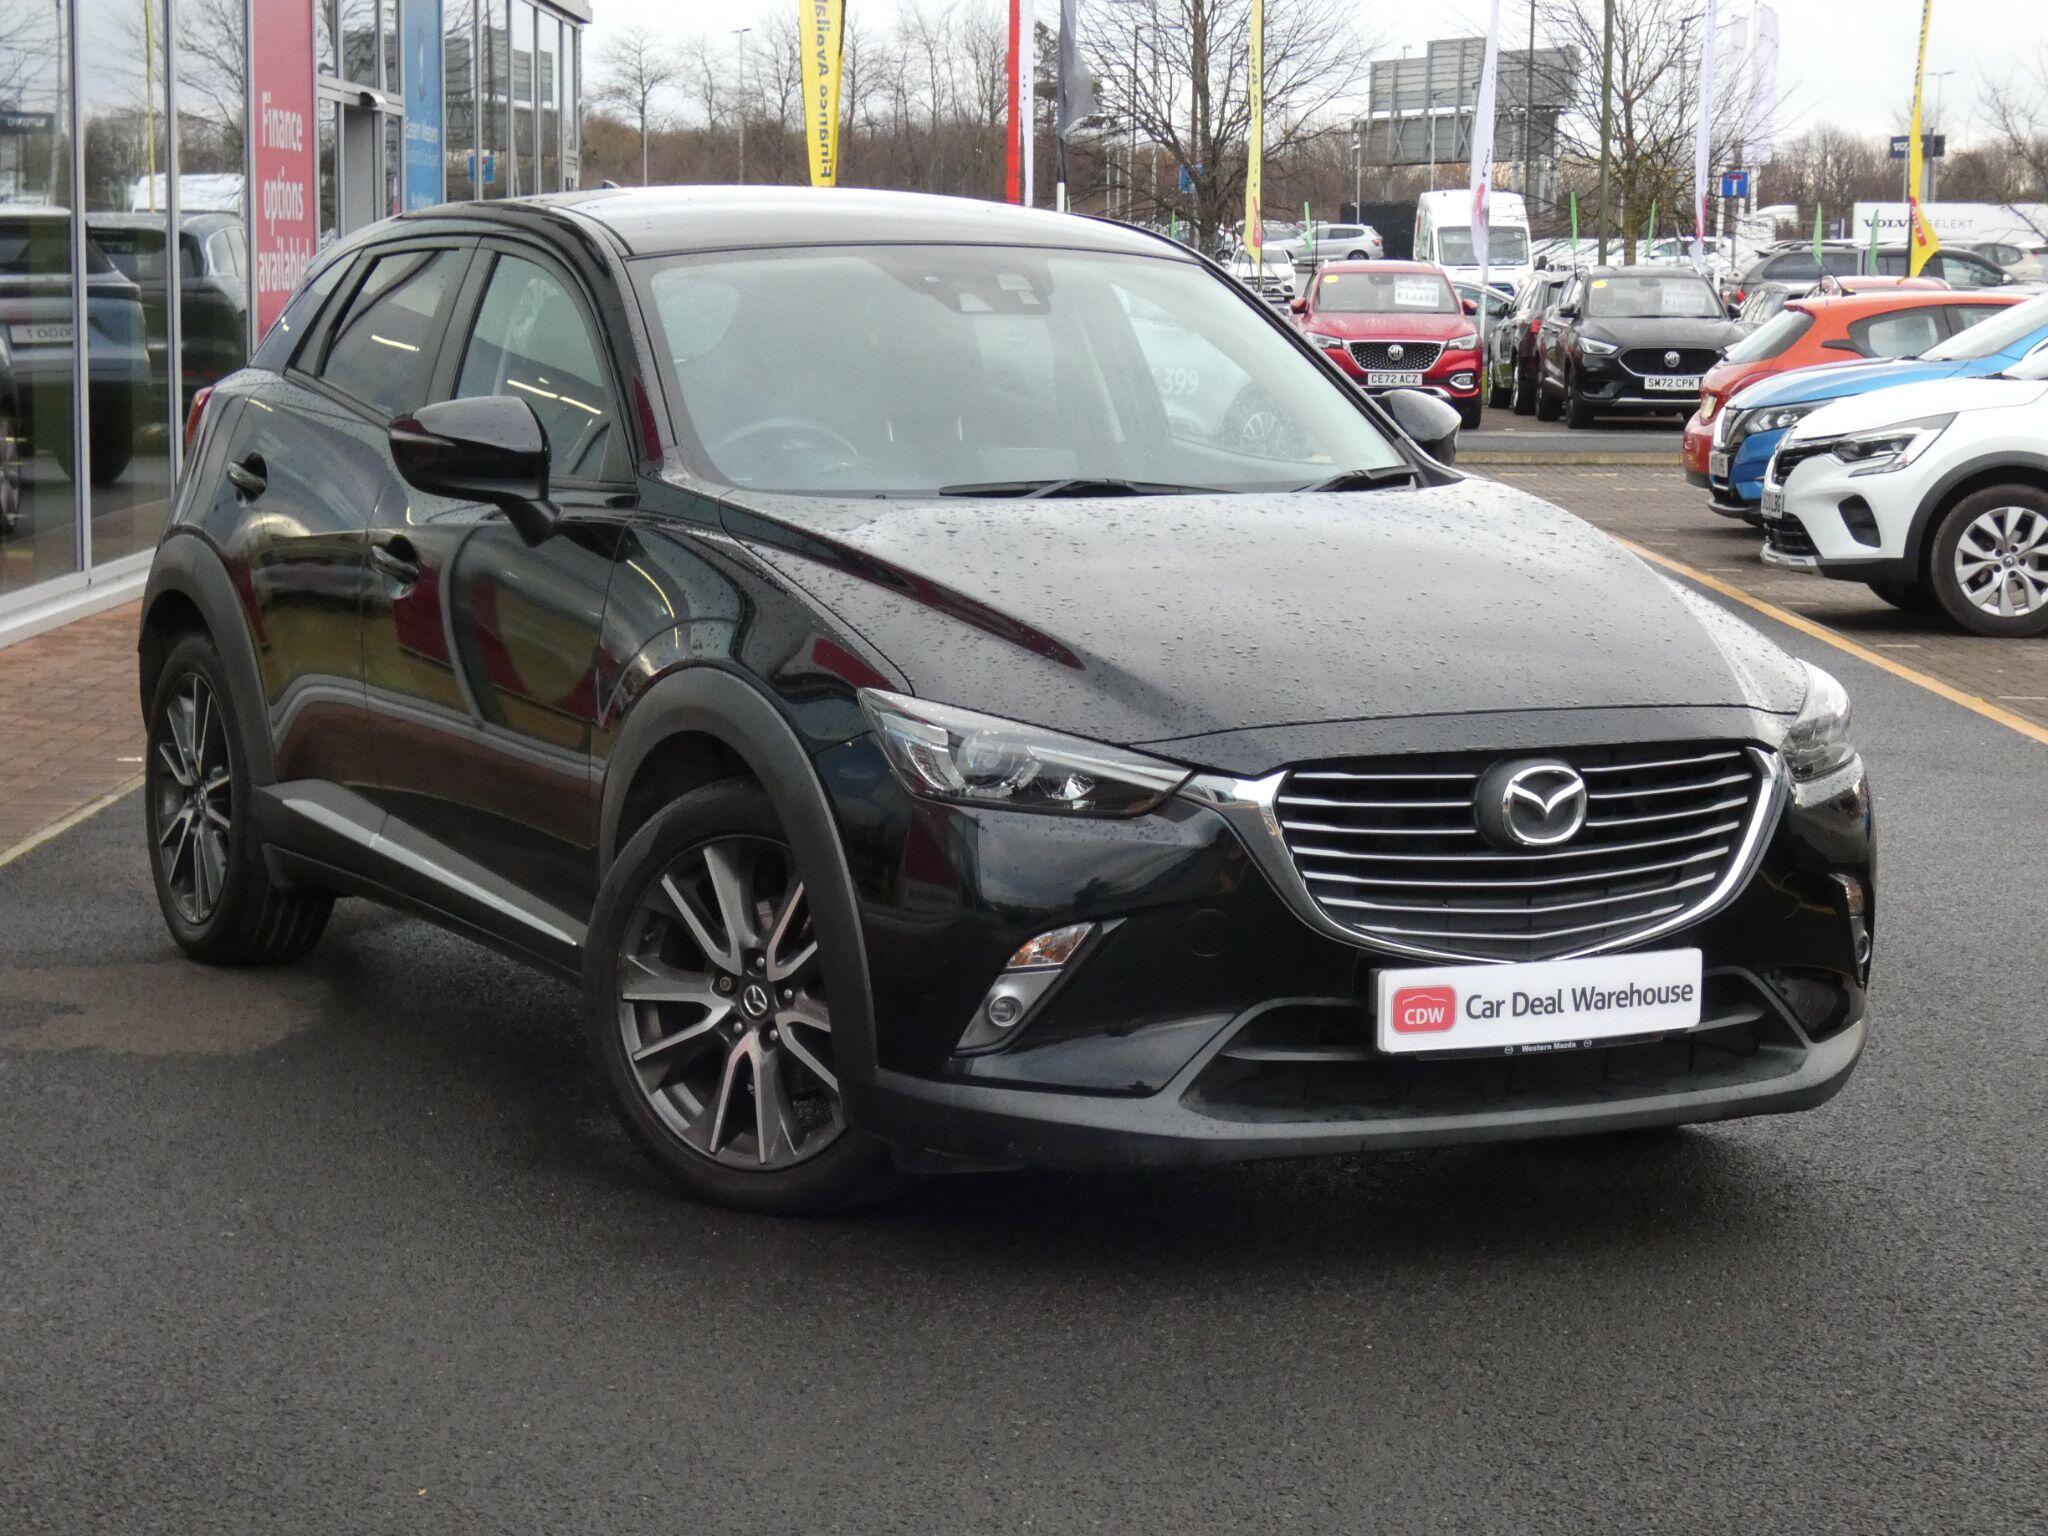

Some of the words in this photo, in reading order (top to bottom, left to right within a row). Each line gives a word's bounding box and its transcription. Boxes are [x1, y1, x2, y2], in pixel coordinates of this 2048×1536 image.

[261, 90, 303, 153] Finance
[263, 164, 304, 237] options
[1863, 219, 1908, 228] VOLV
[1371, 374, 1397, 384] CE72
[1400, 374, 1419, 384] ACZ
[1648, 378, 1673, 388] SM72
[1675, 378, 1695, 388] CPK
[1466, 994, 1506, 1020] Car
[1512, 988, 1564, 1018] Deal
[1571, 981, 1694, 1012] Warehouse
[1404, 1007, 1445, 1025] CDW
[1553, 1041, 1577, 1049] Mazda
